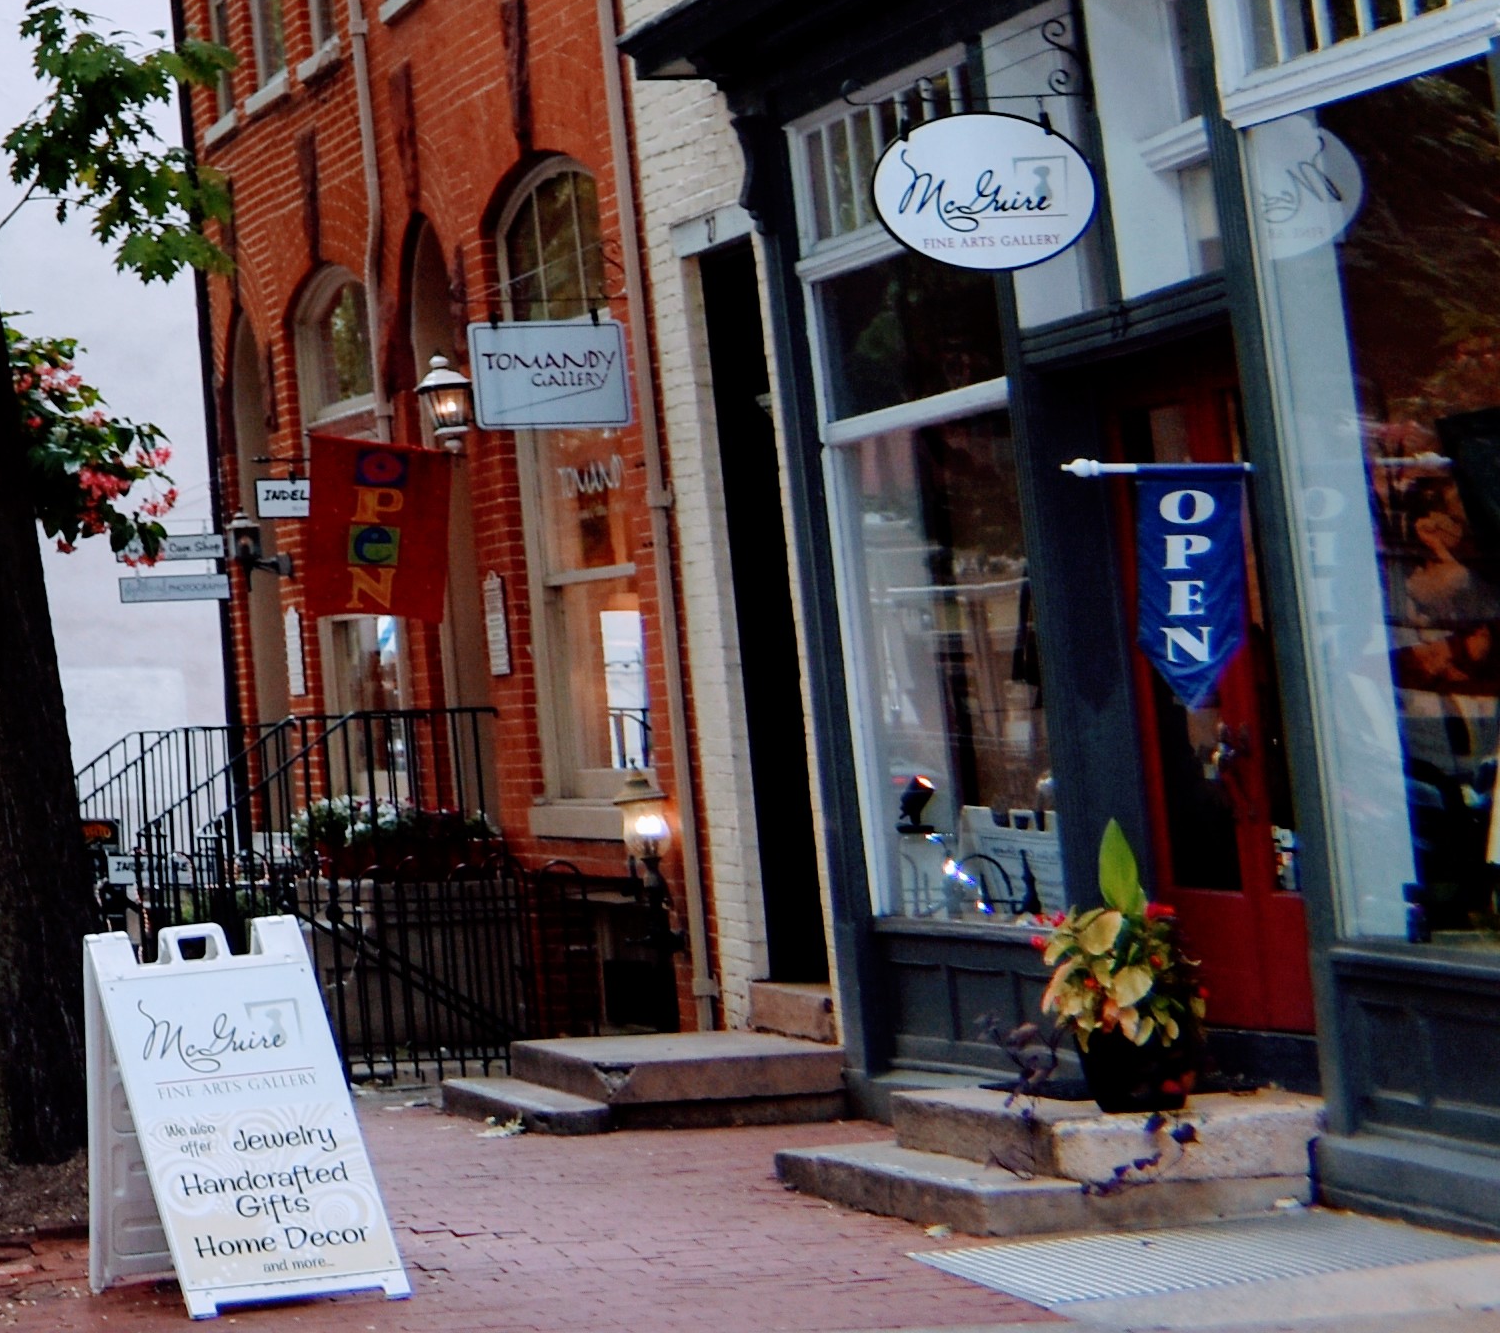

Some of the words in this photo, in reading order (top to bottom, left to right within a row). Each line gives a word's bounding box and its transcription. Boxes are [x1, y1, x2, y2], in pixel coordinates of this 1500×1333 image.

[899, 149, 1051, 232] McGuire
[923, 237, 954, 249] FINE
[960, 235, 996, 248] ARTS
[1000, 233, 1061, 246] GALLERY
[482, 350, 616, 371] TOMANDY
[531, 370, 610, 388] GALLERY
[264, 489, 309, 501] INDEL
[1160, 489, 1215, 663] OPEN
[138, 999, 285, 1073] McGuire
[157, 1086, 196, 1100] FINE
[202, 1081, 242, 1095] ARTS
[248, 1072, 317, 1091] GALLERY
[165, 1123, 185, 1137] We
[190, 1122, 216, 1135] also
[233, 1125, 338, 1152] Jewelry
[180, 1141, 212, 1157] offer
[181, 1161, 349, 1196] Handcrafted
[236, 1194, 310, 1223] Gifts
[196, 1235, 277, 1258] Home
[284, 1226, 369, 1250] Decor
[264, 1259, 288, 1273] and
